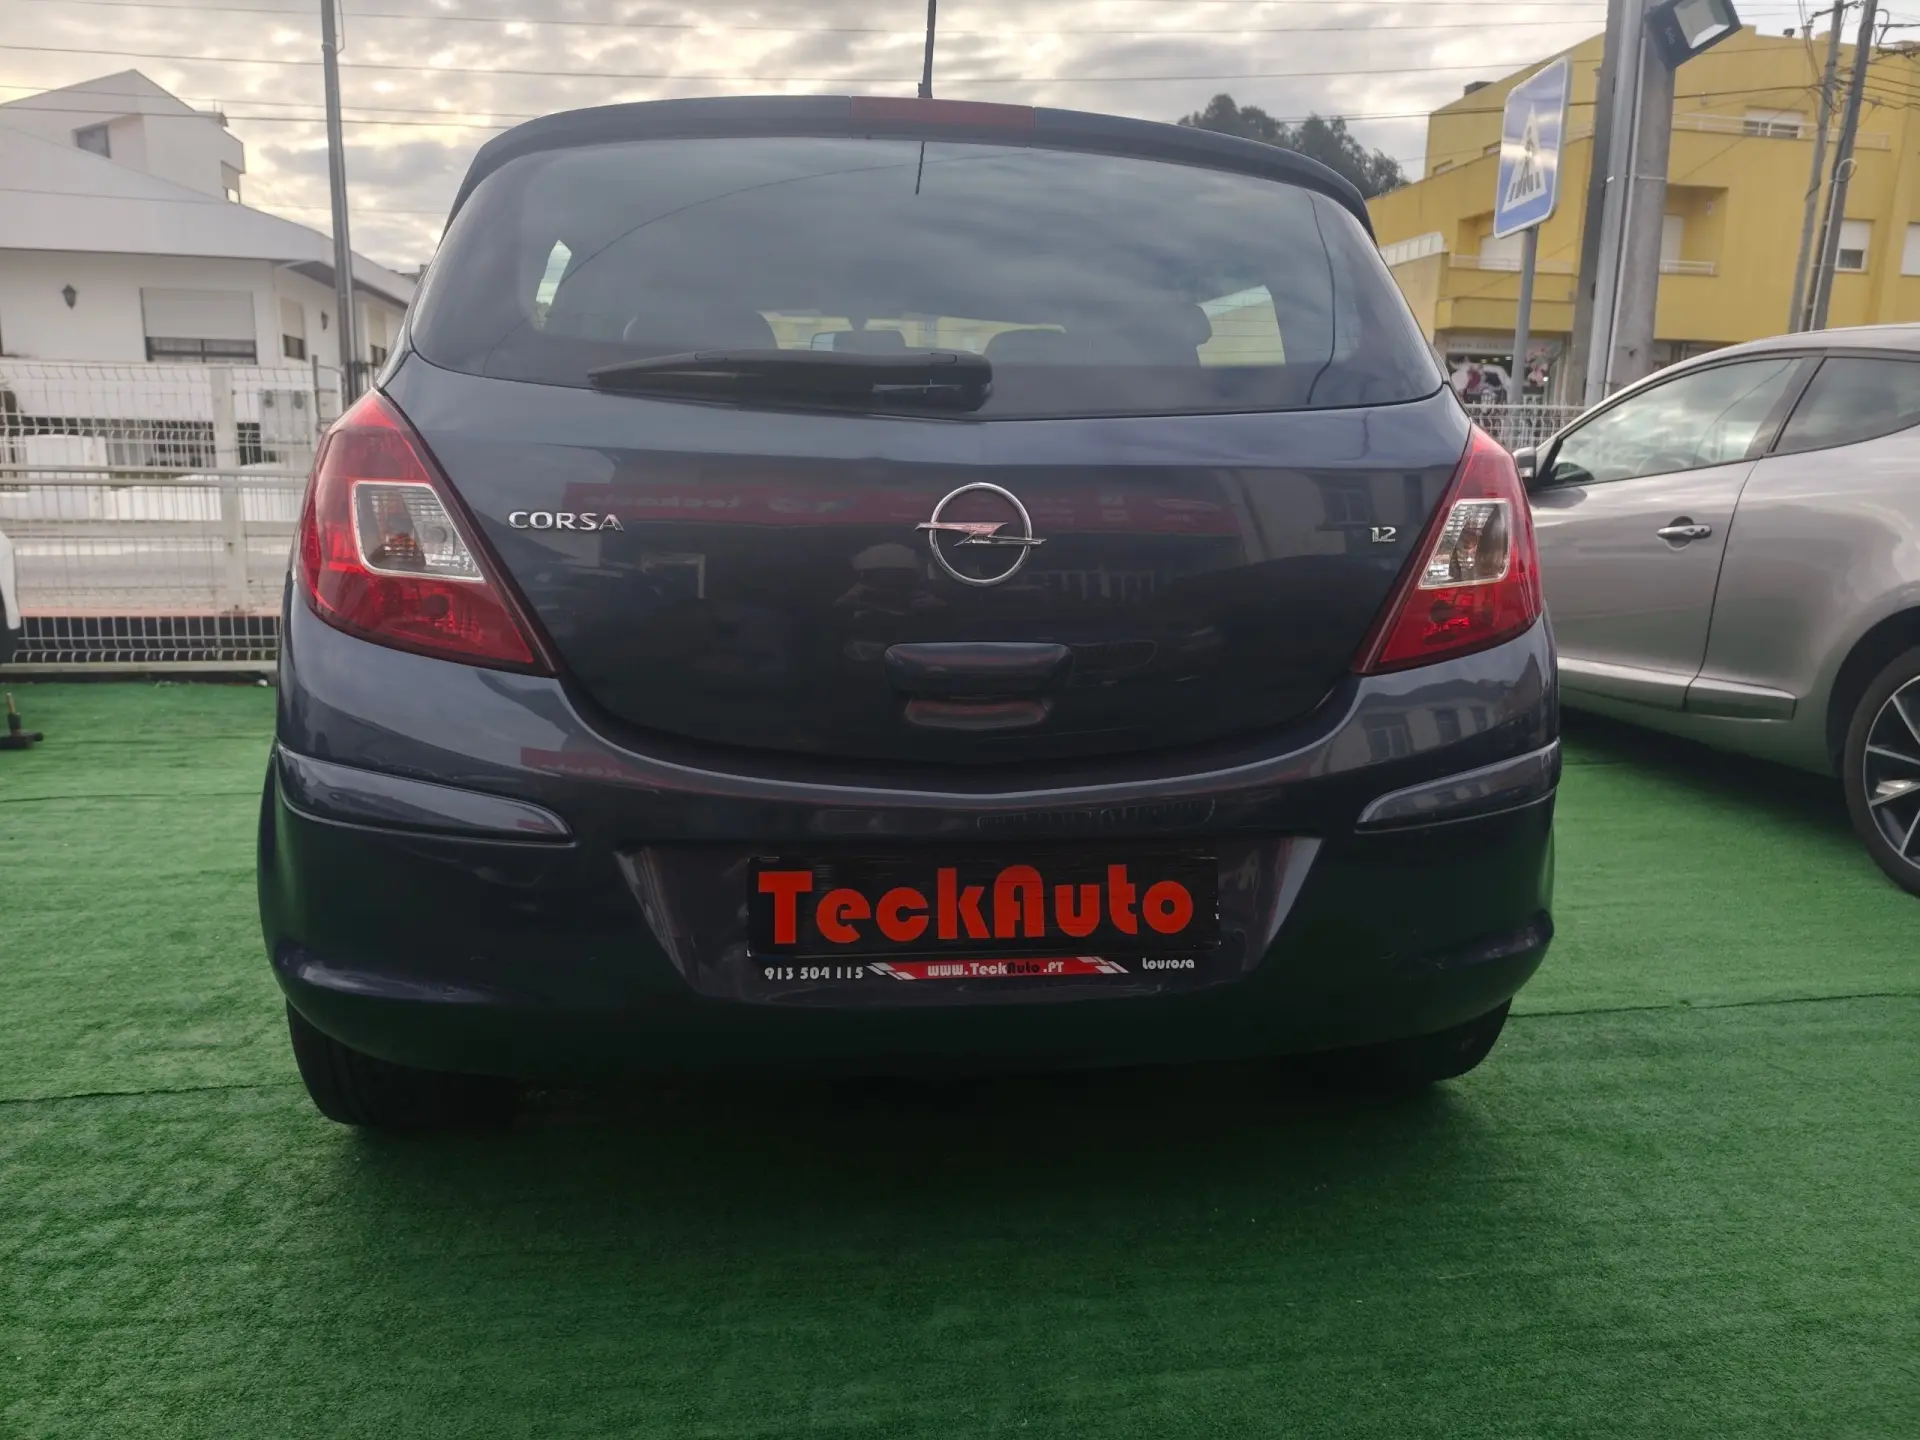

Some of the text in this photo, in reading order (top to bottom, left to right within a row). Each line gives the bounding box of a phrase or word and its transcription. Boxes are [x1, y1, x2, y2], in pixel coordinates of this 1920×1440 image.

[508, 511, 625, 531] CORSA
[758, 864, 1193, 945] TeckAuto
[1142, 957, 1195, 970] Lourosa
[764, 966, 864, 980] 913 504 115
